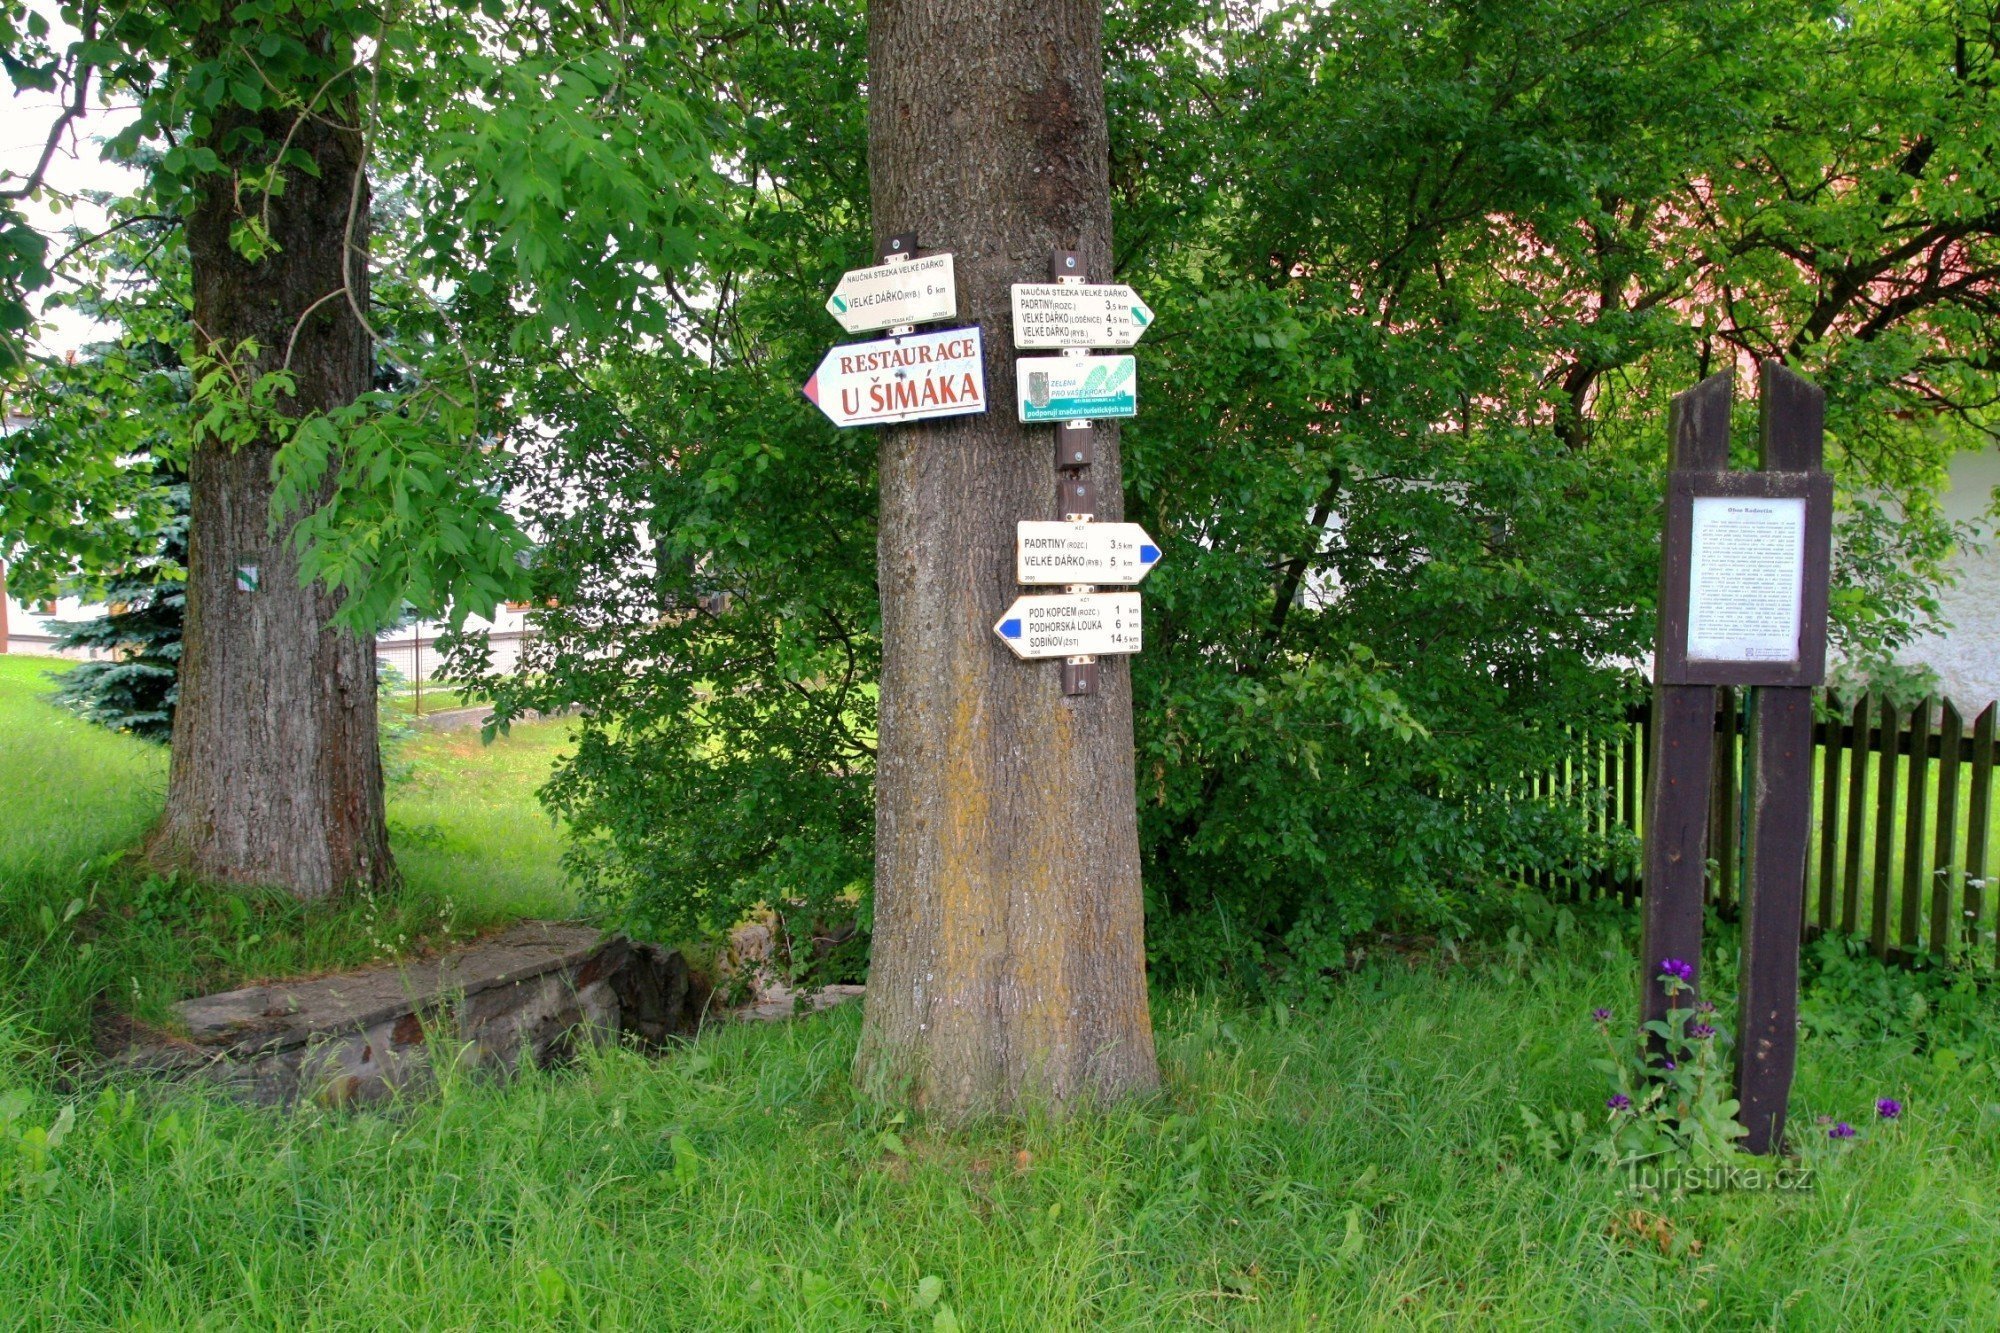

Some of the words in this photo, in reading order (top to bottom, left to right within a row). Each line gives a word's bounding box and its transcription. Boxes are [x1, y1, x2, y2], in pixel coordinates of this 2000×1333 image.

[847, 272, 873, 283] NAUČNÁ
[873, 269, 898, 279] STEZKA
[898, 263, 919, 274] VELKÉ
[920, 260, 944, 270] DÁŘKO
[849, 295, 874, 308] VELKÉ
[876, 288, 902, 304] DÁŘKO
[926, 285, 933, 295] 6
[1021, 288, 1050, 296] NAUČNÁ
[1052, 288, 1078, 296] STEZKA
[1080, 288, 1102, 296] VELKÉ
[1104, 288, 1128, 297] DÁŘKO
[1021, 299, 1052, 309] PADRTINY
[1106, 300, 1116, 310] 3,5
[1022, 311, 1044, 323] VELKÉ
[1045, 310, 1068, 323] DÁŘKO
[1106, 314, 1117, 324] 4,5
[1023, 325, 1044, 336] VELKÉ
[1046, 324, 1069, 336] DÁŘKO
[1070, 329, 1088, 338] (RYB.)
[1107, 328, 1112, 336] 5
[840, 338, 975, 374] RESTAURACE
[842, 387, 860, 415] U
[870, 369, 978, 412] ŠIMÁKA
[1028, 408, 1058, 418] podporují
[1060, 406, 1082, 416] značení
[1084, 405, 1119, 414] turistických
[1024, 538, 1066, 548] PADRTINY
[1066, 542, 1088, 550] (ROZC.)
[1110, 540, 1122, 550] 3,5
[1024, 554, 1052, 566] VELKÉ
[1054, 554, 1085, 566] DÁŘKO
[1086, 559, 1102, 568] (RYB.)
[1110, 556, 1116, 566] 5
[1030, 608, 1044, 618] POD
[1046, 606, 1076, 617] KOPCEM
[1078, 608, 1100, 617] (ROZC.)
[1115, 605, 1120, 614] 1
[1030, 620, 1076, 632] PODHORSKÁ
[1078, 620, 1102, 630] LOUKA
[1115, 619, 1121, 628] 6
[1030, 635, 1062, 647] SOBIŇOV
[1111, 634, 1128, 644] 14,5
